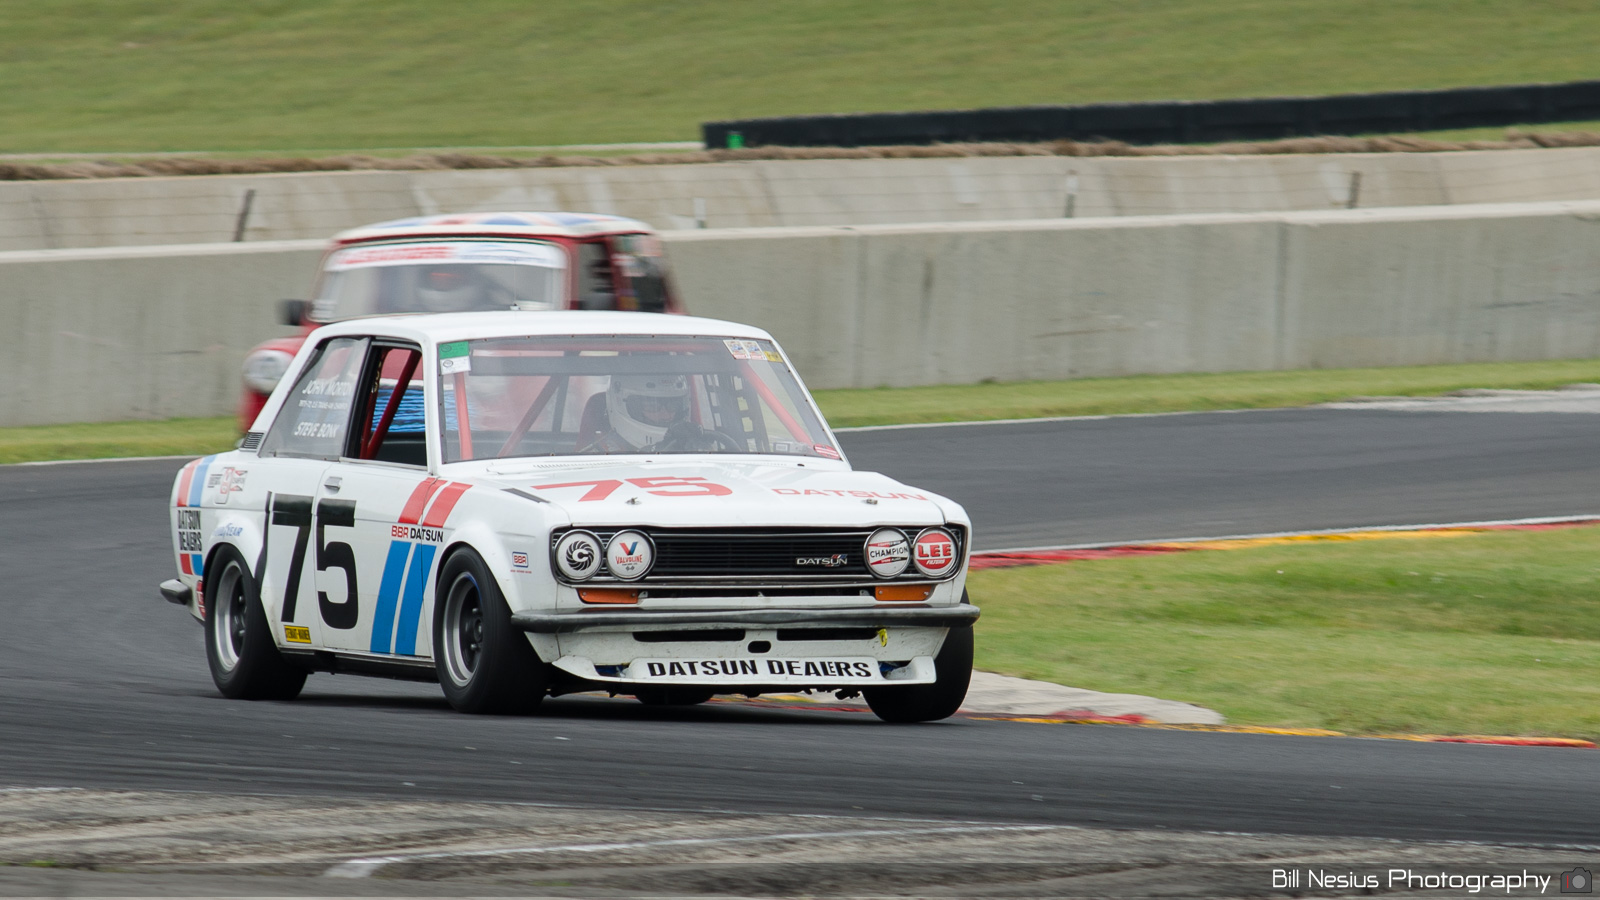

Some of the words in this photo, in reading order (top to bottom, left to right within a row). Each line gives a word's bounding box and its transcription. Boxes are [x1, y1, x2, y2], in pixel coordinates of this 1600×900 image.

[302, 380, 325, 394] JOHN
[294, 421, 320, 436] STEVE
[316, 423, 341, 438] BONK
[530, 476, 733, 502] 75
[772, 488, 928, 501] DATSUN
[178, 509, 201, 530] DATSUN
[213, 523, 243, 538] YEAR
[391, 525, 409, 538] BBR
[410, 527, 443, 543] DATSUN
[178, 531, 202, 551] DEALERS
[870, 545, 909, 558] CHAMPION
[917, 543, 952, 557] LEE
[271, 492, 358, 630] 75
[513, 555, 527, 564] BBR
[615, 554, 643, 565] VALVOLINE
[796, 557, 848, 565] DATSUN
[647, 659, 759, 677] DATSUN
[766, 659, 872, 678] DEALERS
